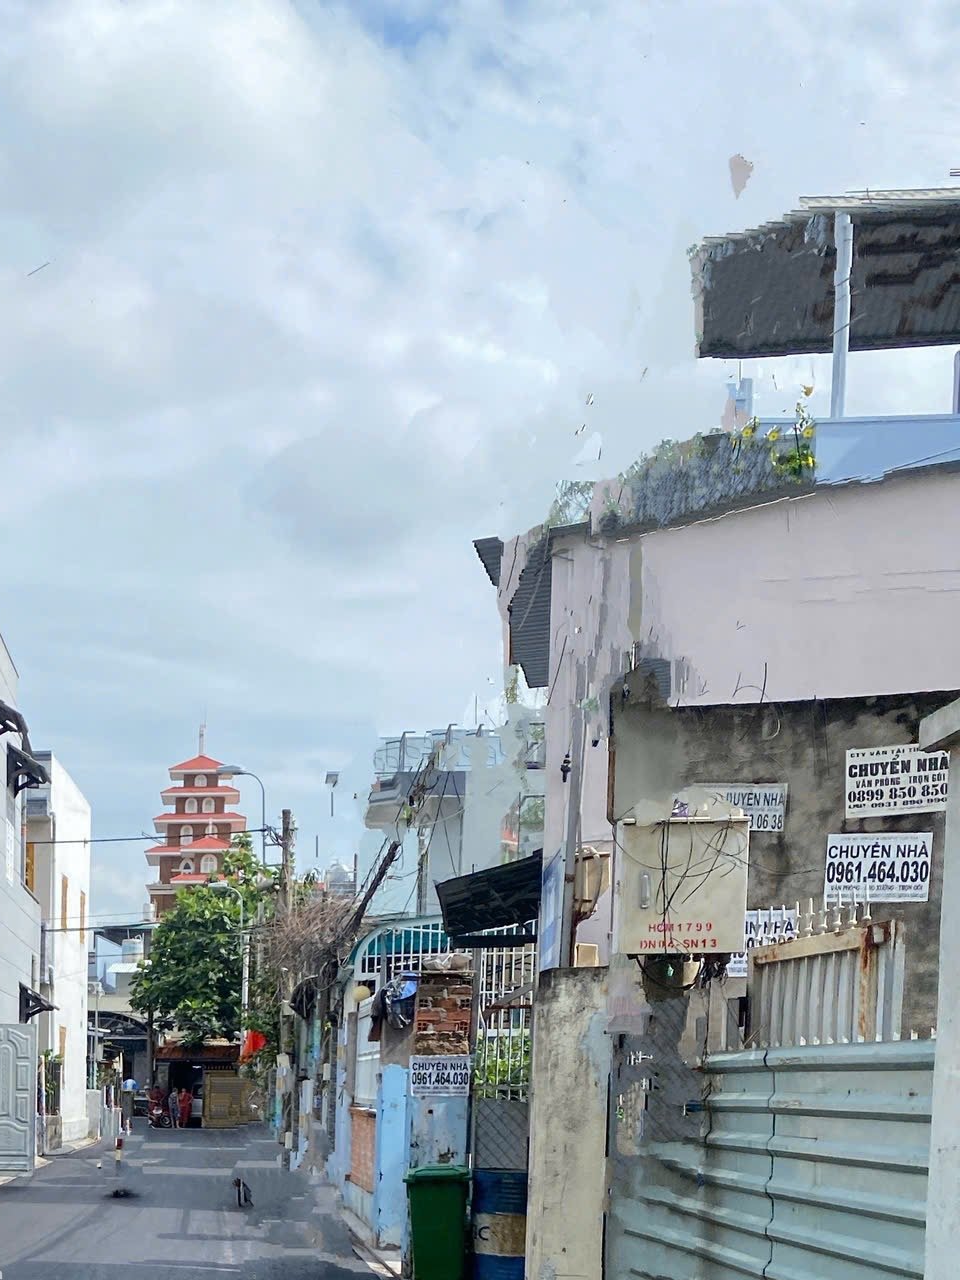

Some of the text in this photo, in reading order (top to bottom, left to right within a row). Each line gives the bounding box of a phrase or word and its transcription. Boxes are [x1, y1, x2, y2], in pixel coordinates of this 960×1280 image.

[848, 752, 949, 778] CHUYỂN NHÀ
[848, 783, 948, 803] 0899 850 850
[756, 814, 769, 829] 06
[828, 841, 929, 859] CHUYỂN NHÀ
[826, 860, 930, 883] 0961.464.030
[411, 1072, 469, 1085] 0961.464.030
